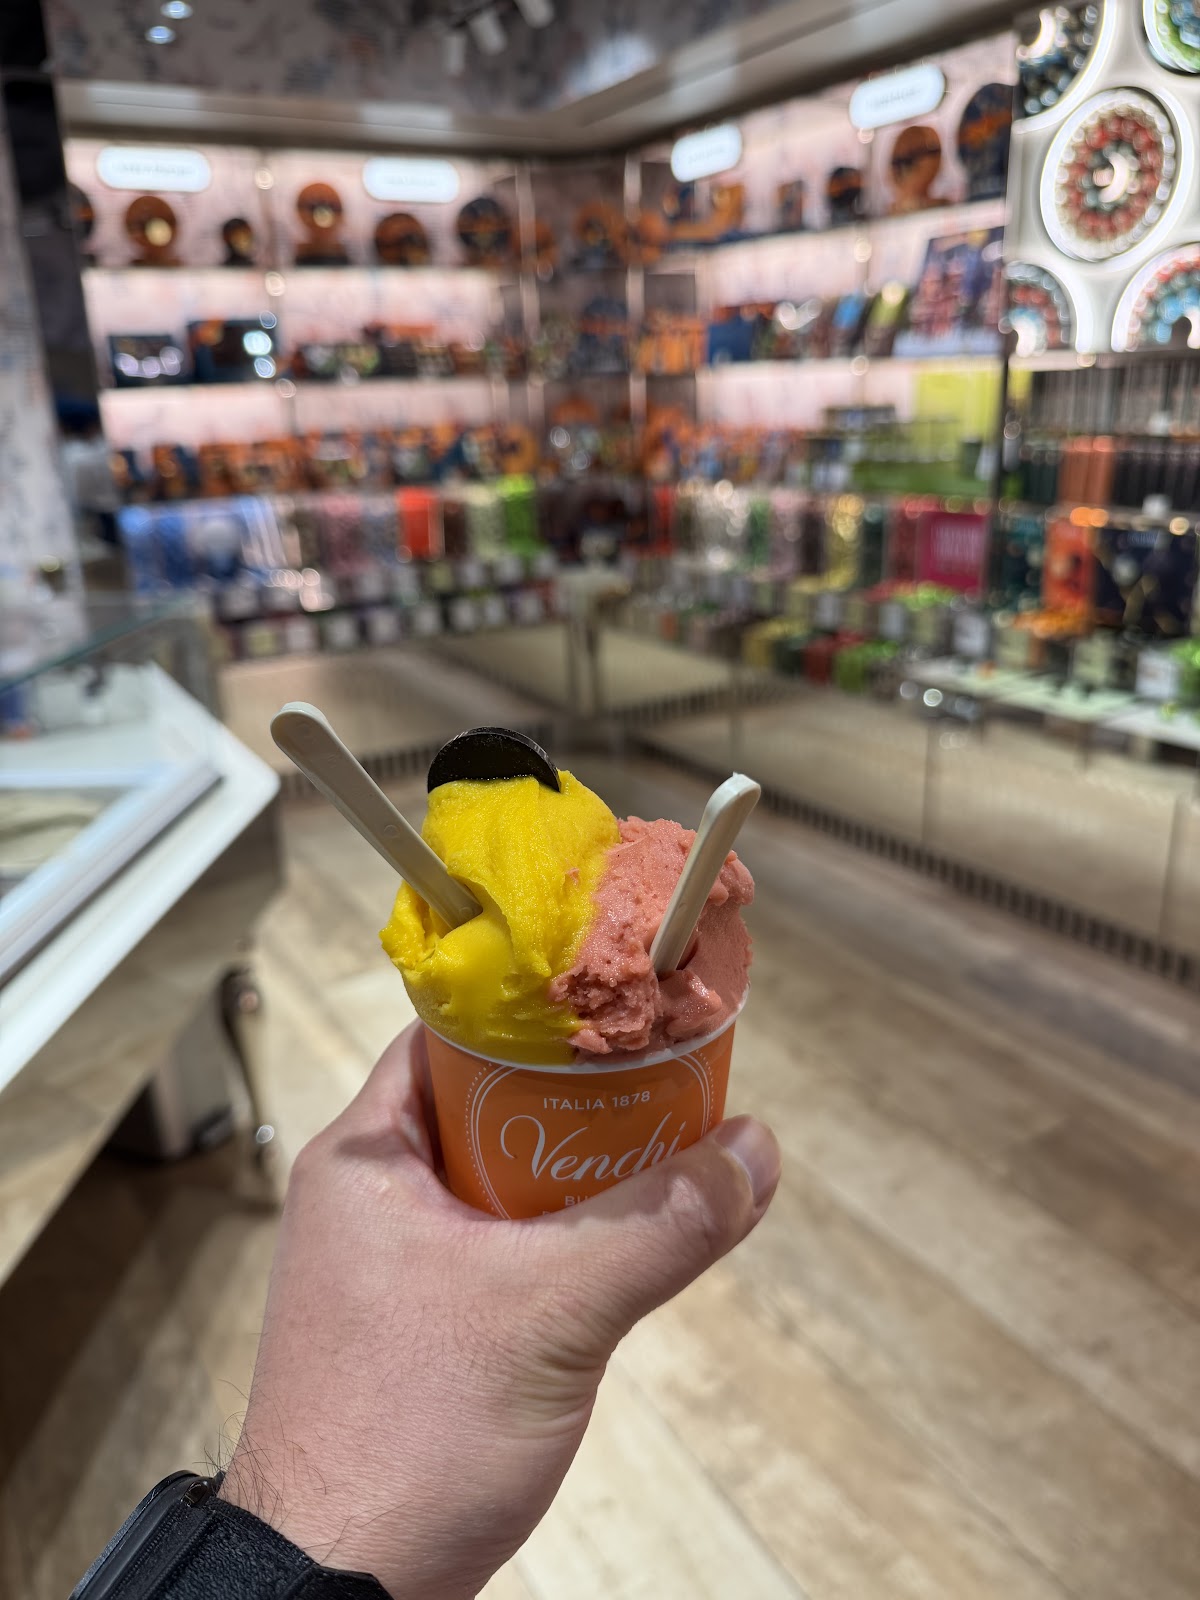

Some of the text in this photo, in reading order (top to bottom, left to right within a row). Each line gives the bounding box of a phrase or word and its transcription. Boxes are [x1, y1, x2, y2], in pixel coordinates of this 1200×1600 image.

[543, 1091, 651, 1110] ITALIA 1878
[500, 1111, 687, 1180] Venchi
